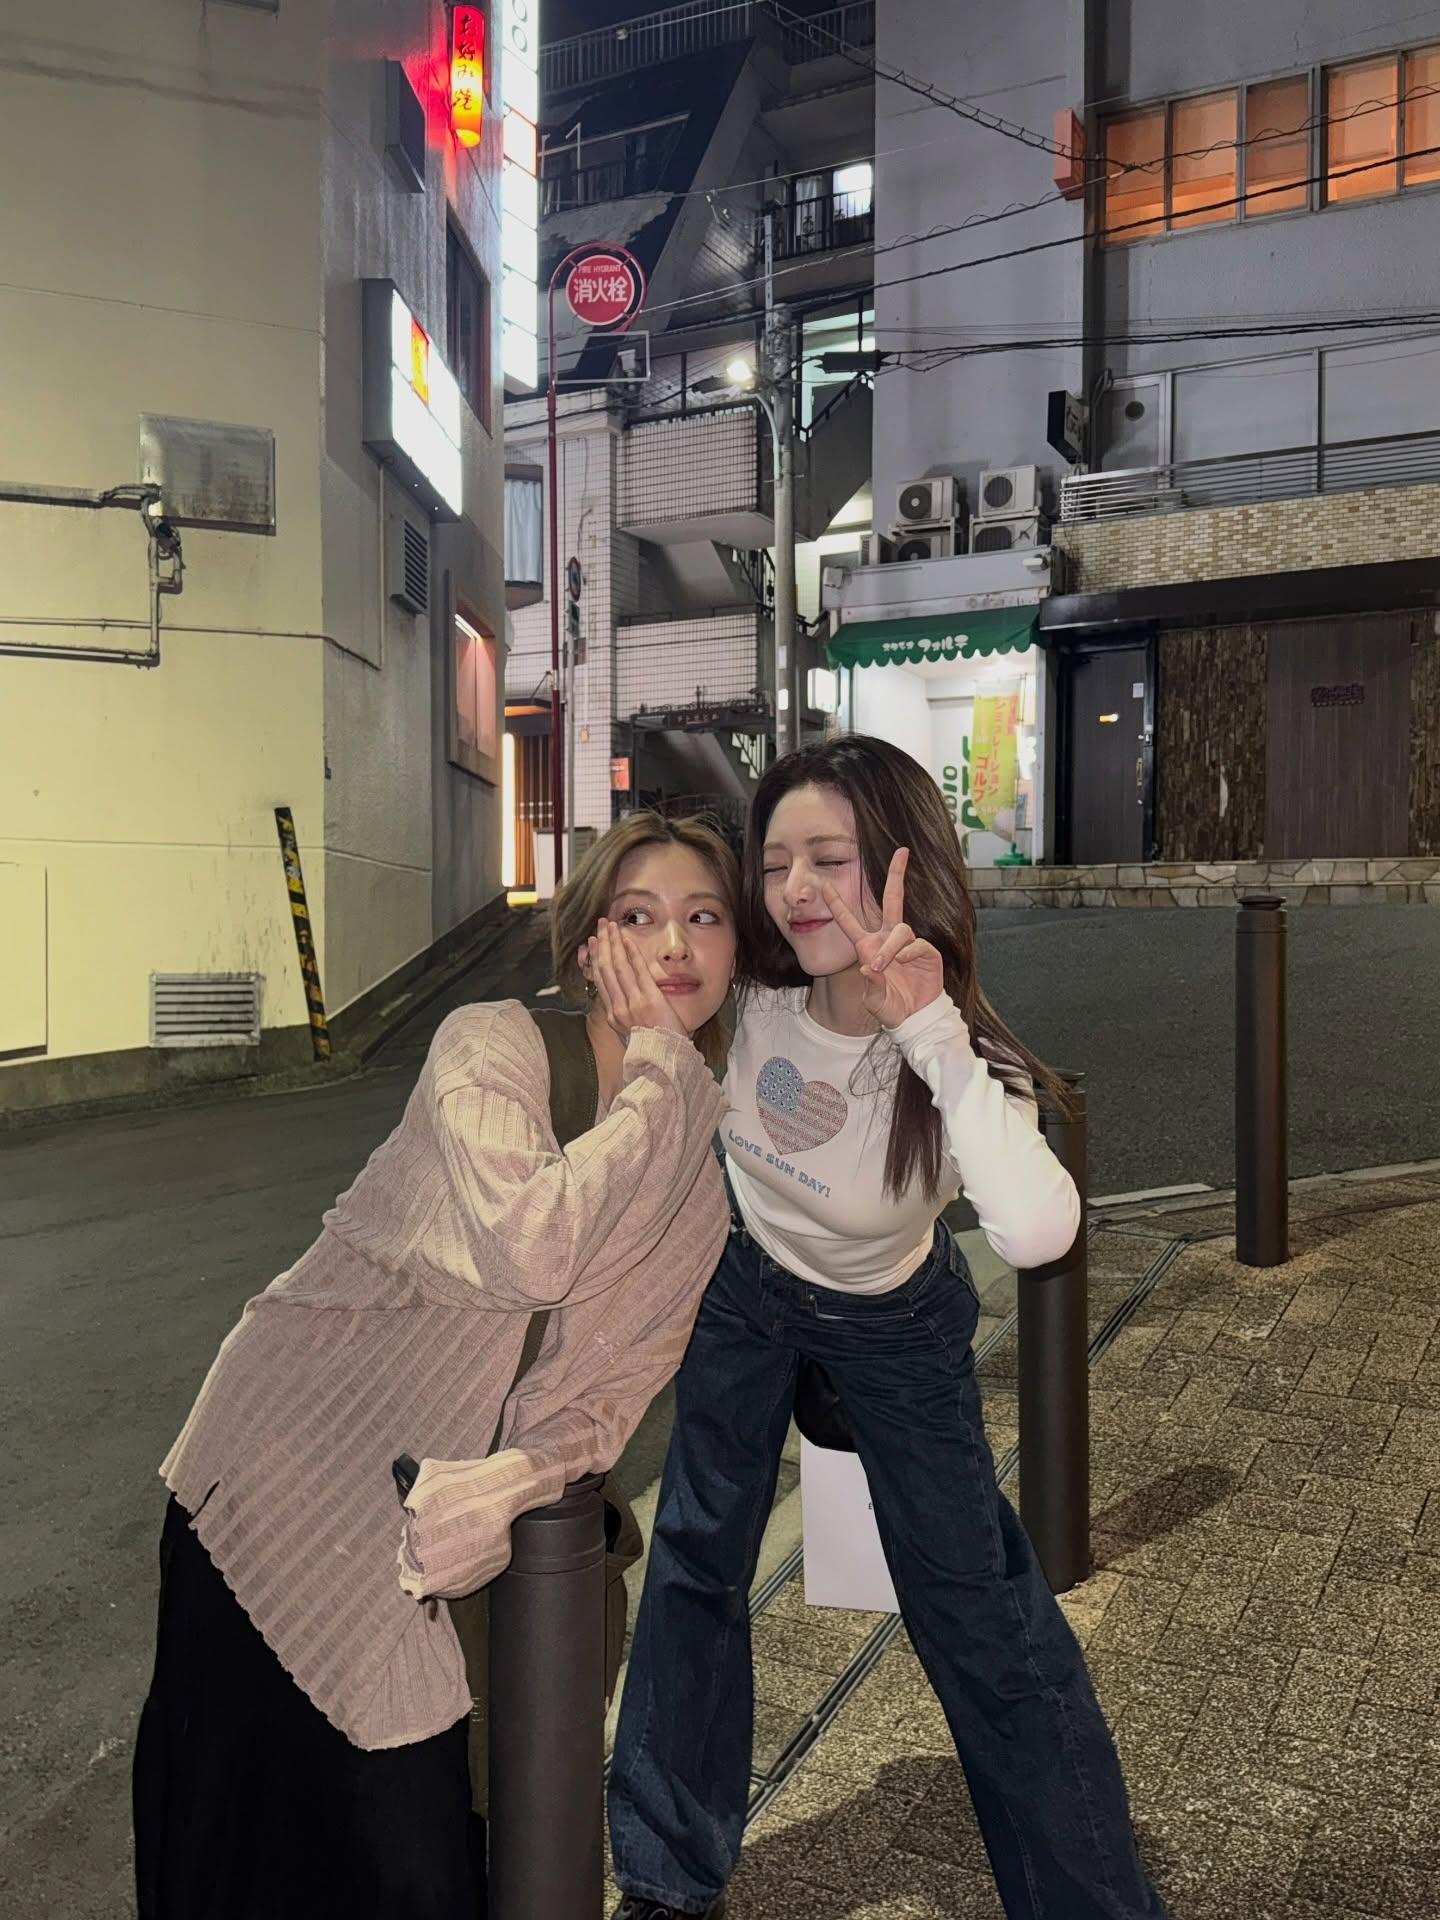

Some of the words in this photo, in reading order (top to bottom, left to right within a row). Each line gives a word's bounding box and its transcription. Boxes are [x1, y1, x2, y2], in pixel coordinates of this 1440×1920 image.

[578, 265, 592, 274] FIRE
[593, 264, 621, 273] HYDRANT
[573, 276, 628, 304] 消火栓
[974, 756, 989, 803] ゴルフ
[728, 1129, 763, 1157] LOVE
[766, 1153, 796, 1177] SUN
[798, 1170, 832, 1198] DAY!
